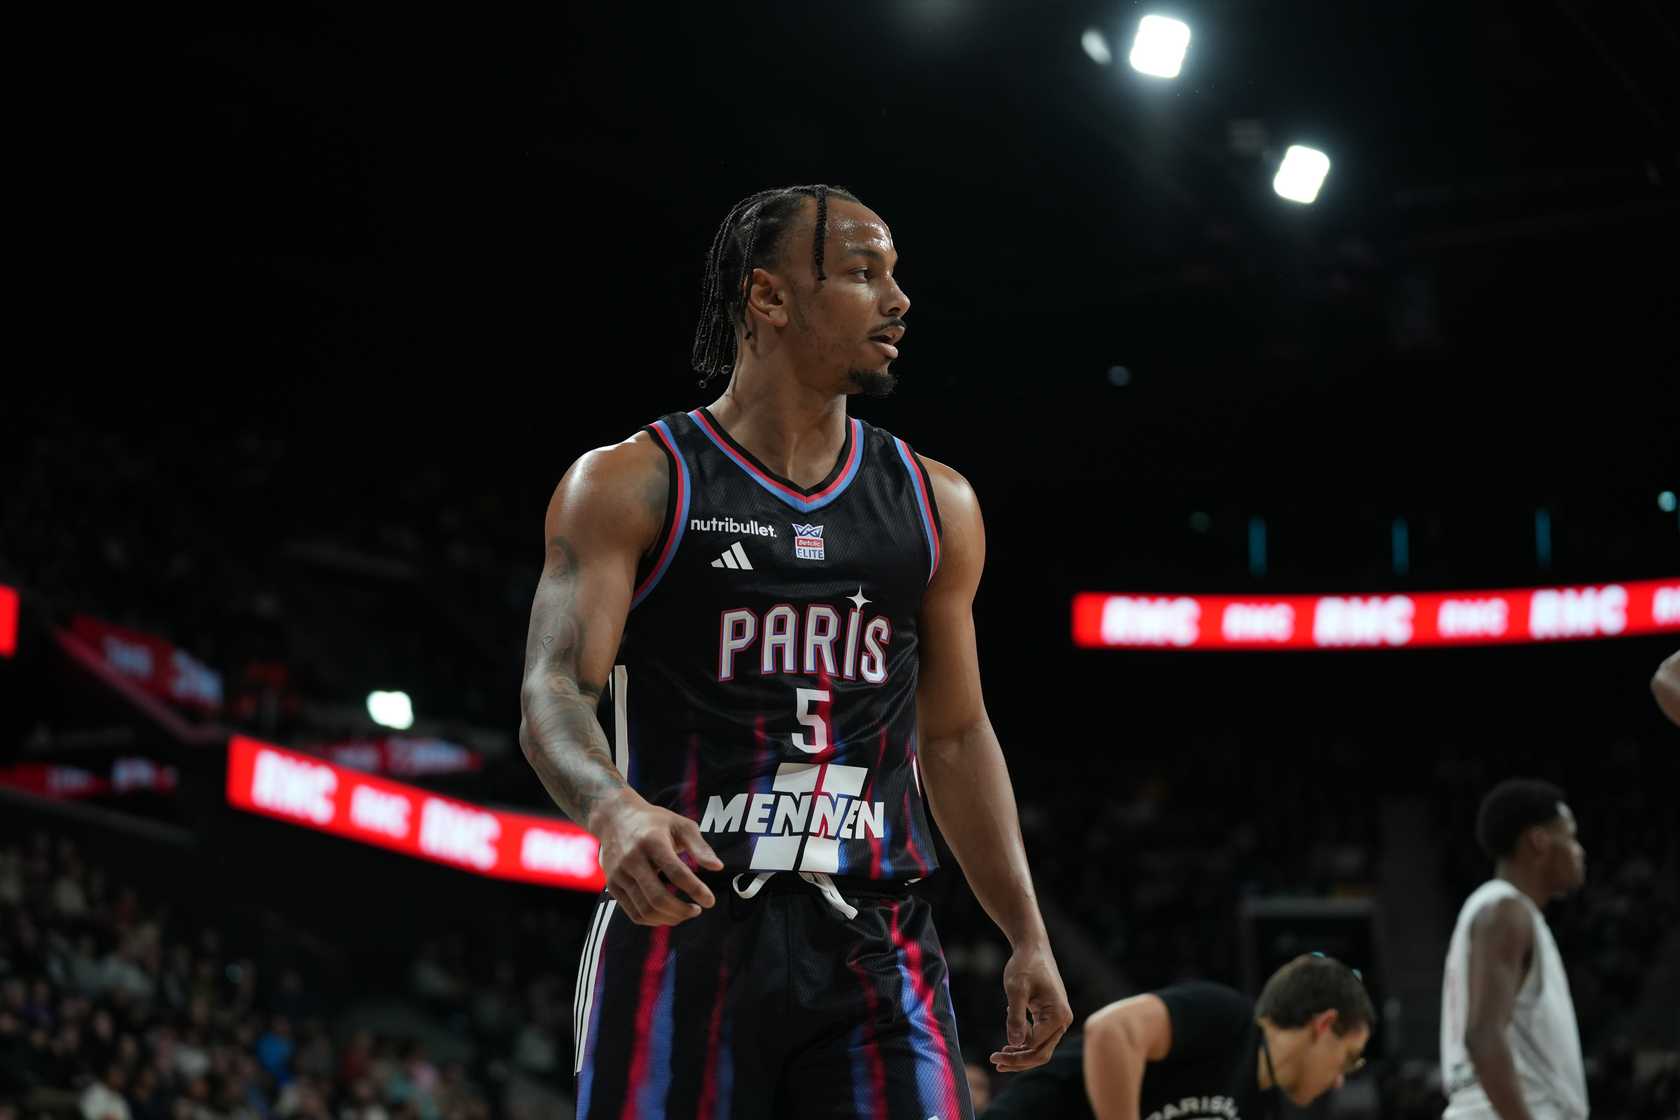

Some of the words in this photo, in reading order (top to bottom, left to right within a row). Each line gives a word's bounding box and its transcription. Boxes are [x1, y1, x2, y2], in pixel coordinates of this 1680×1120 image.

[797, 548, 824, 559] ELITE
[718, 603, 893, 685] PARIS
[791, 687, 831, 754] 5
[699, 793, 886, 840] MENNEN
